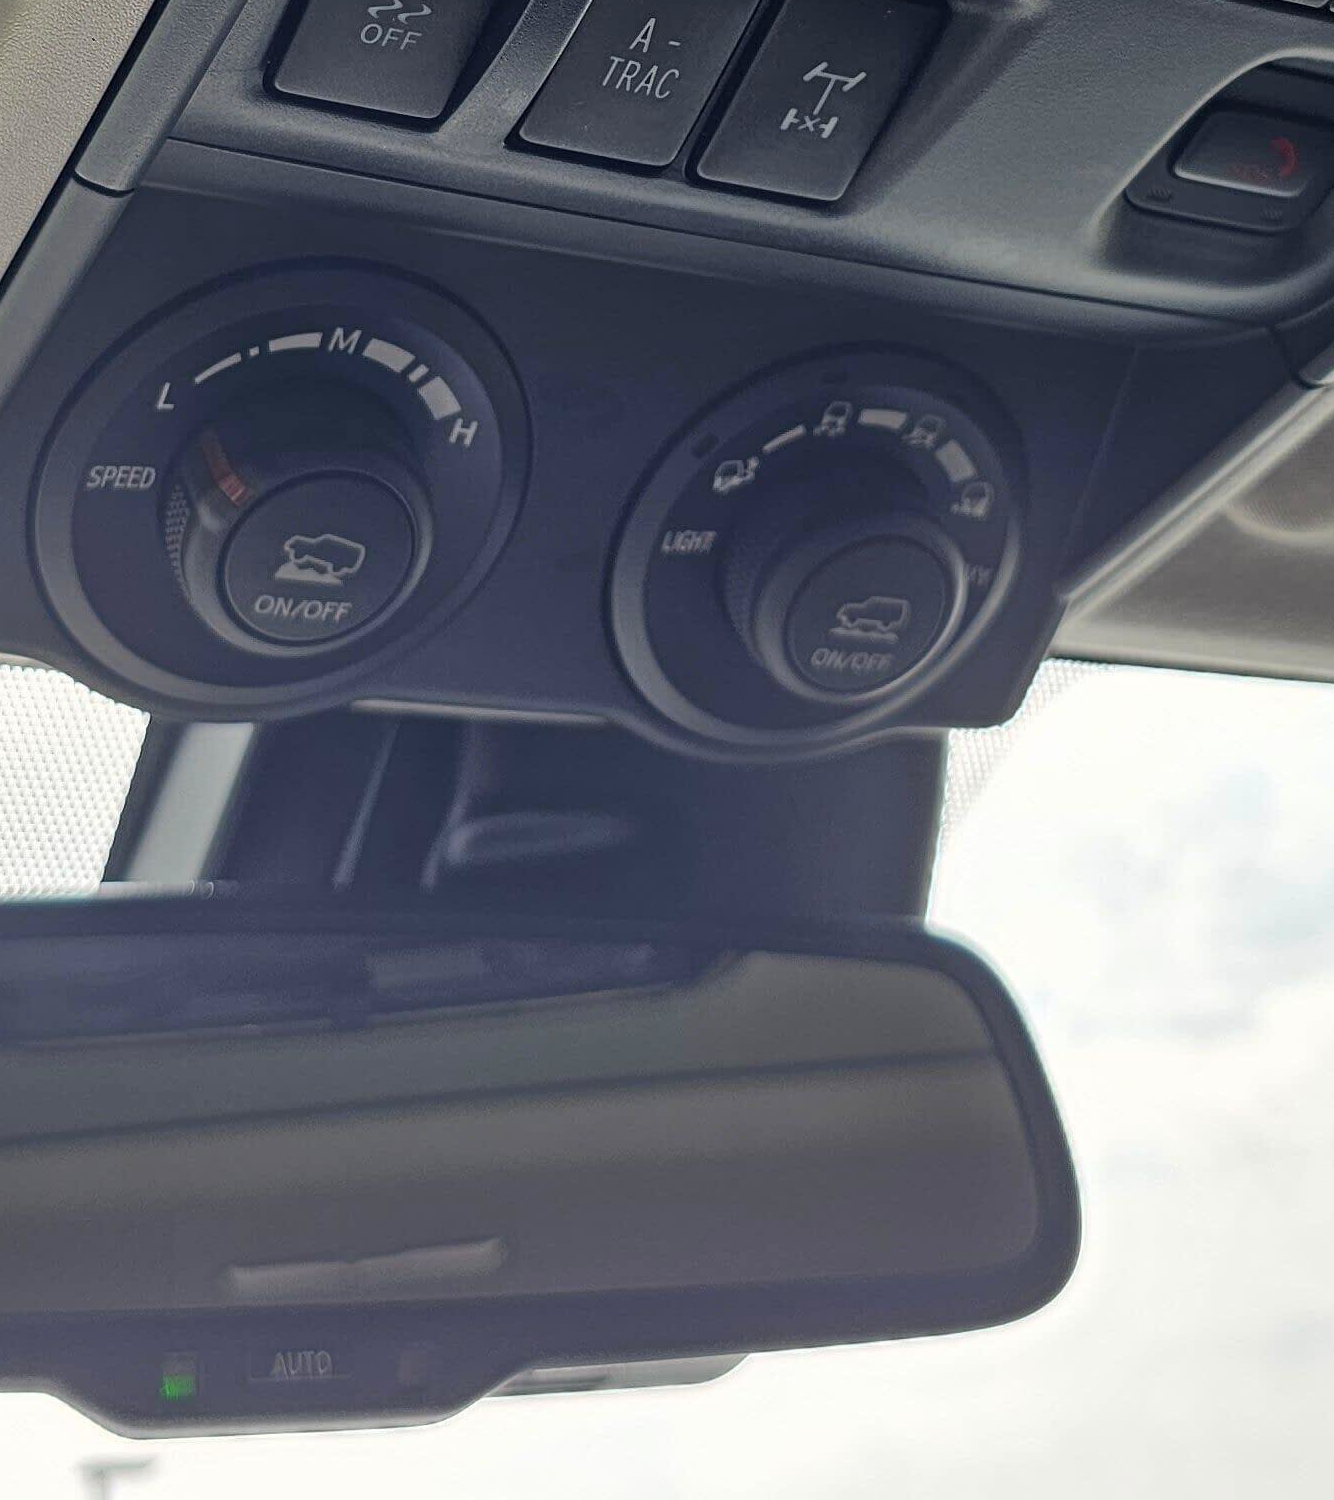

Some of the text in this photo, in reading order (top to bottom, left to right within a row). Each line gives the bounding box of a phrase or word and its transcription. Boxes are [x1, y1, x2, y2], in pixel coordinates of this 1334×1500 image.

[359, 22, 423, 52] OFF
[599, 56, 681, 101] TRAC
[327, 327, 362, 355] M
[156, 382, 176, 412] L
[448, 419, 478, 449] H
[87, 464, 156, 490] SPEED
[661, 529, 719, 555] LIGHT
[253, 594, 352, 623] ON/OFF
[810, 647, 895, 673] ON/OFF
[269, 1350, 334, 1381] AUTO
